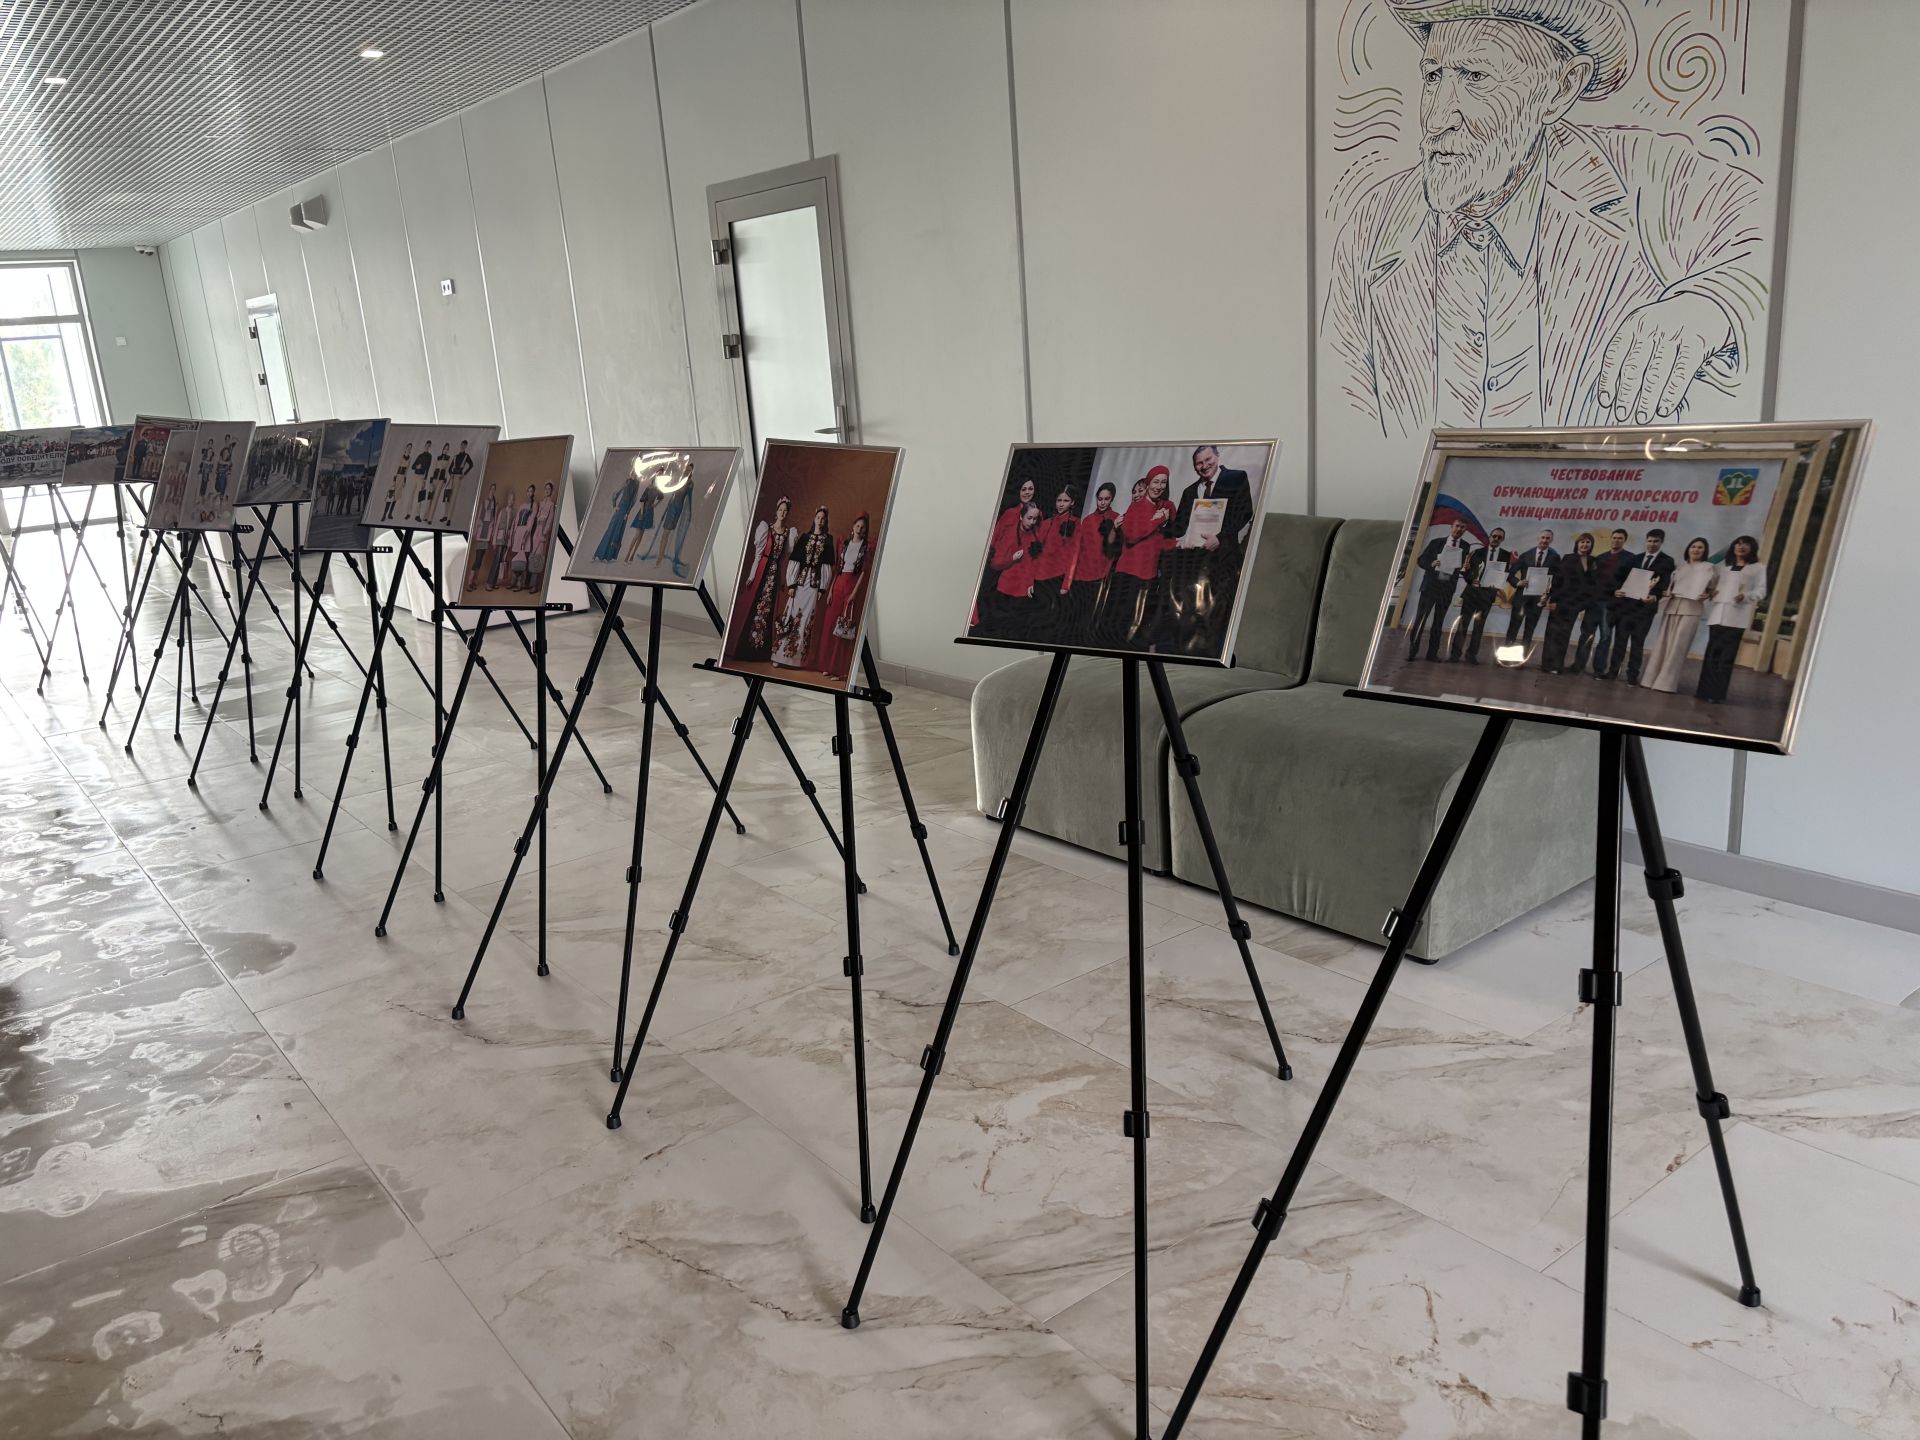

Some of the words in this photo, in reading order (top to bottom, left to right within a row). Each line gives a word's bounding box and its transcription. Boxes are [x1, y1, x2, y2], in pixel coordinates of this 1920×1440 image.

[1550, 468, 1645, 481] ЧЕСТВОВАНИЕ
[1493, 485, 1589, 502] ОБУЧАЮЩИХСЯ
[1594, 488, 1699, 503] КУКМОРСКОГО
[1499, 505, 1619, 521] МУНИЦИПАЛЬНОГО
[1621, 505, 1680, 523] РАЙОНА
